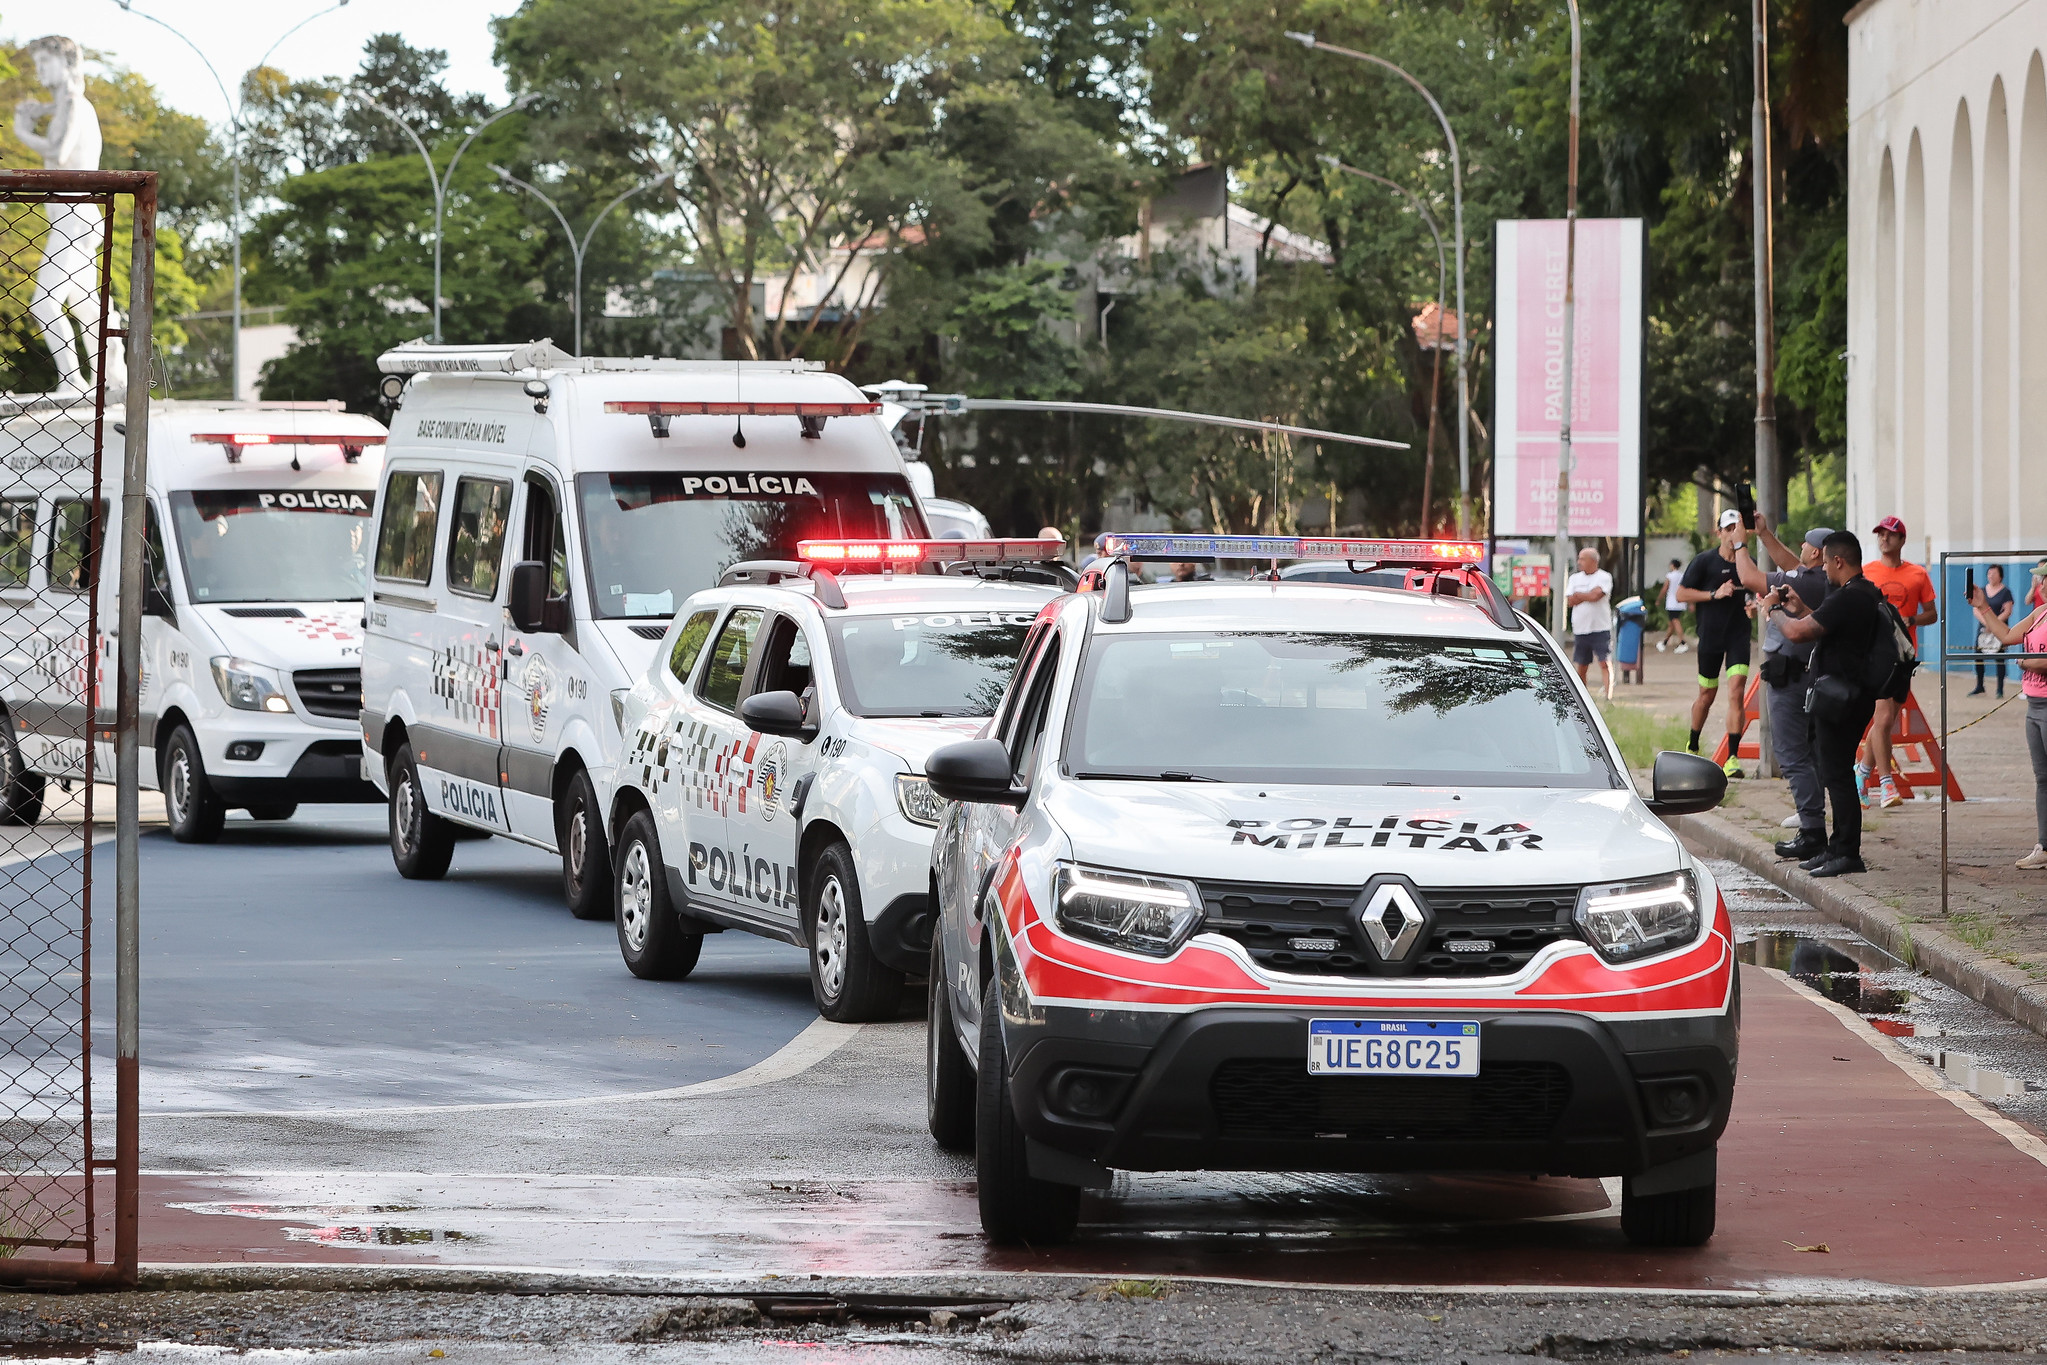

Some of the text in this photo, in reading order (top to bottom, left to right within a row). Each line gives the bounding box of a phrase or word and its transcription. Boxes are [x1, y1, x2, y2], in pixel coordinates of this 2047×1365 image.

[1544, 247, 1564, 422] PARQUE CERET
[417, 418, 507, 444] BASE COMUNITÁRIA MÓVEL
[682, 473, 818, 496] POLÍCIA
[258, 490, 368, 510] POLÍCIA
[1568, 490, 1605, 504] AULO
[575, 680, 587, 700] 190
[829, 738, 847, 758] 190
[441, 780, 499, 823] POLÍCIA
[1226, 814, 1532, 836] POLÍCIA
[1230, 831, 1545, 853] MILITAR
[688, 842, 798, 909] POLÍCIA
[1380, 1023, 1408, 1032] BRASIL
[1326, 1038, 1462, 1070] UEG8C25
[1311, 1061, 1321, 1071] BR
